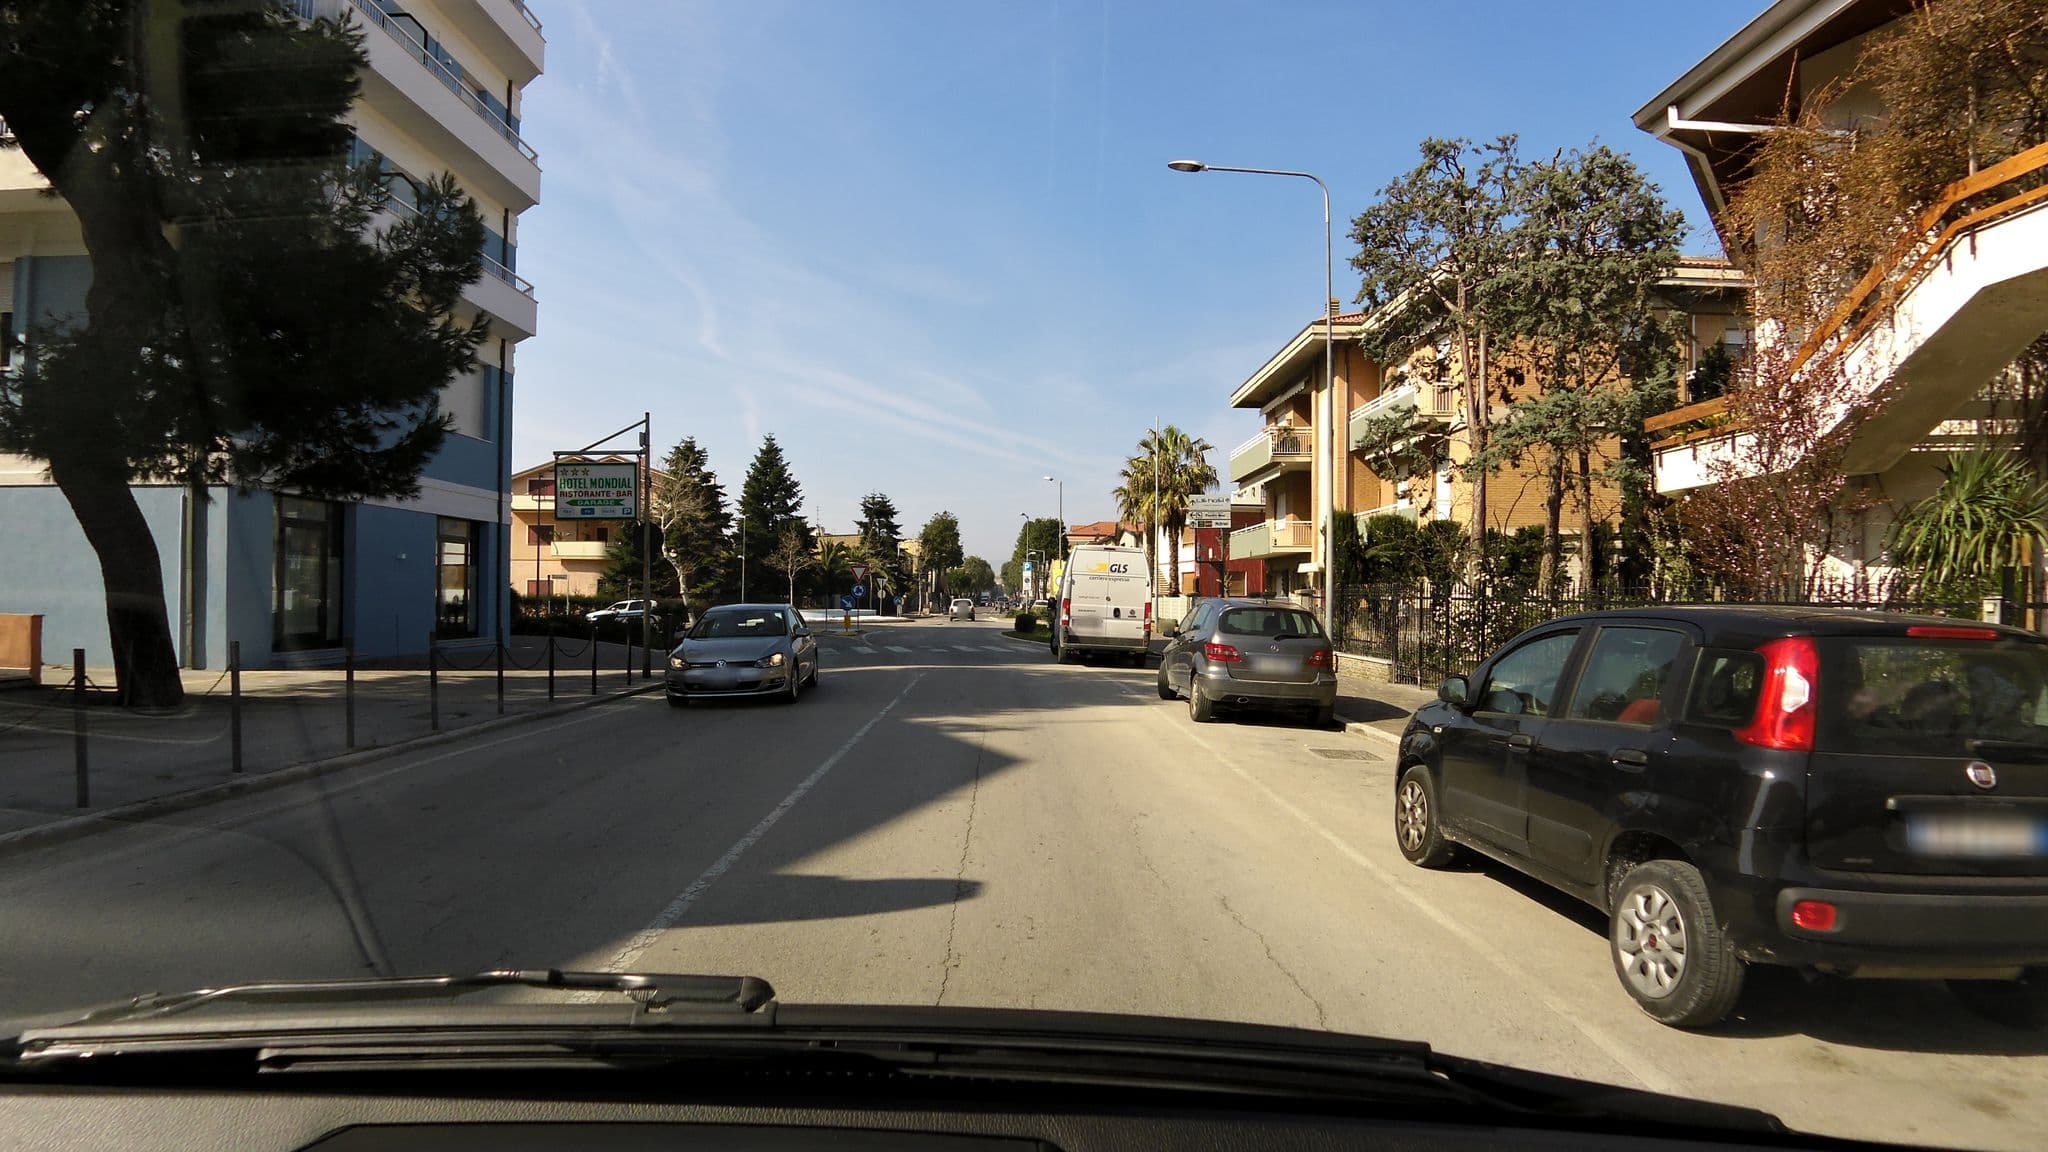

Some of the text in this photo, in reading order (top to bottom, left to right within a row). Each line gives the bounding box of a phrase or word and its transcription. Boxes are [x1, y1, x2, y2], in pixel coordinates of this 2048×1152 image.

[559, 478, 632, 489] HOTEL MONDIAL
[559, 490, 611, 498] RISTORANTE
[1110, 563, 1129, 574] GLS
